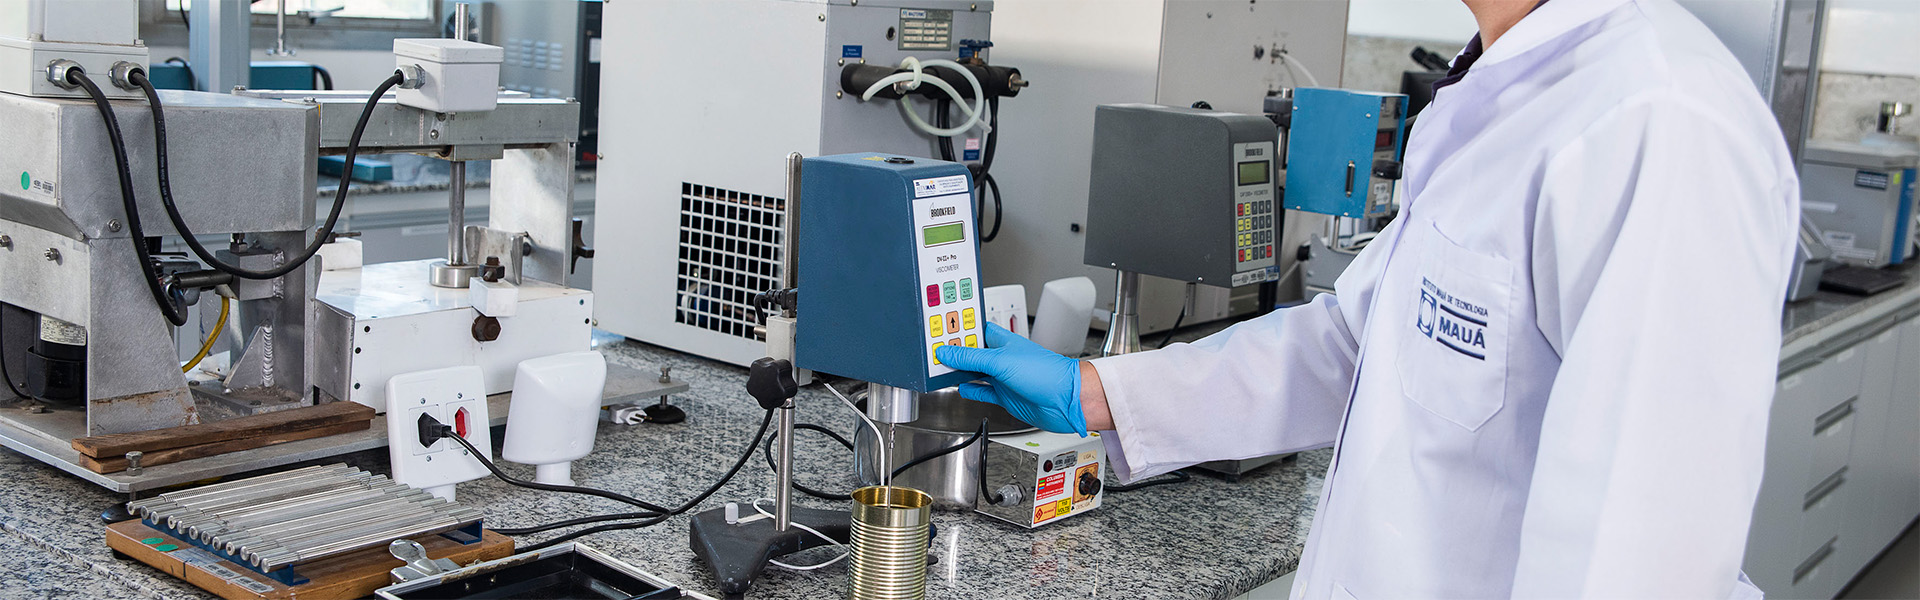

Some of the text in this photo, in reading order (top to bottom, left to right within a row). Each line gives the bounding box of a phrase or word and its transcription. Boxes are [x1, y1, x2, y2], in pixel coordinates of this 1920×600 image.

[930, 206, 956, 218] BROOKFIELD
[935, 264, 959, 273] VISCOMETER
[1447, 294, 1453, 304] DE
[1455, 298, 1488, 317] TECNOLOGIA
[1439, 316, 1486, 349] MAUÁ
